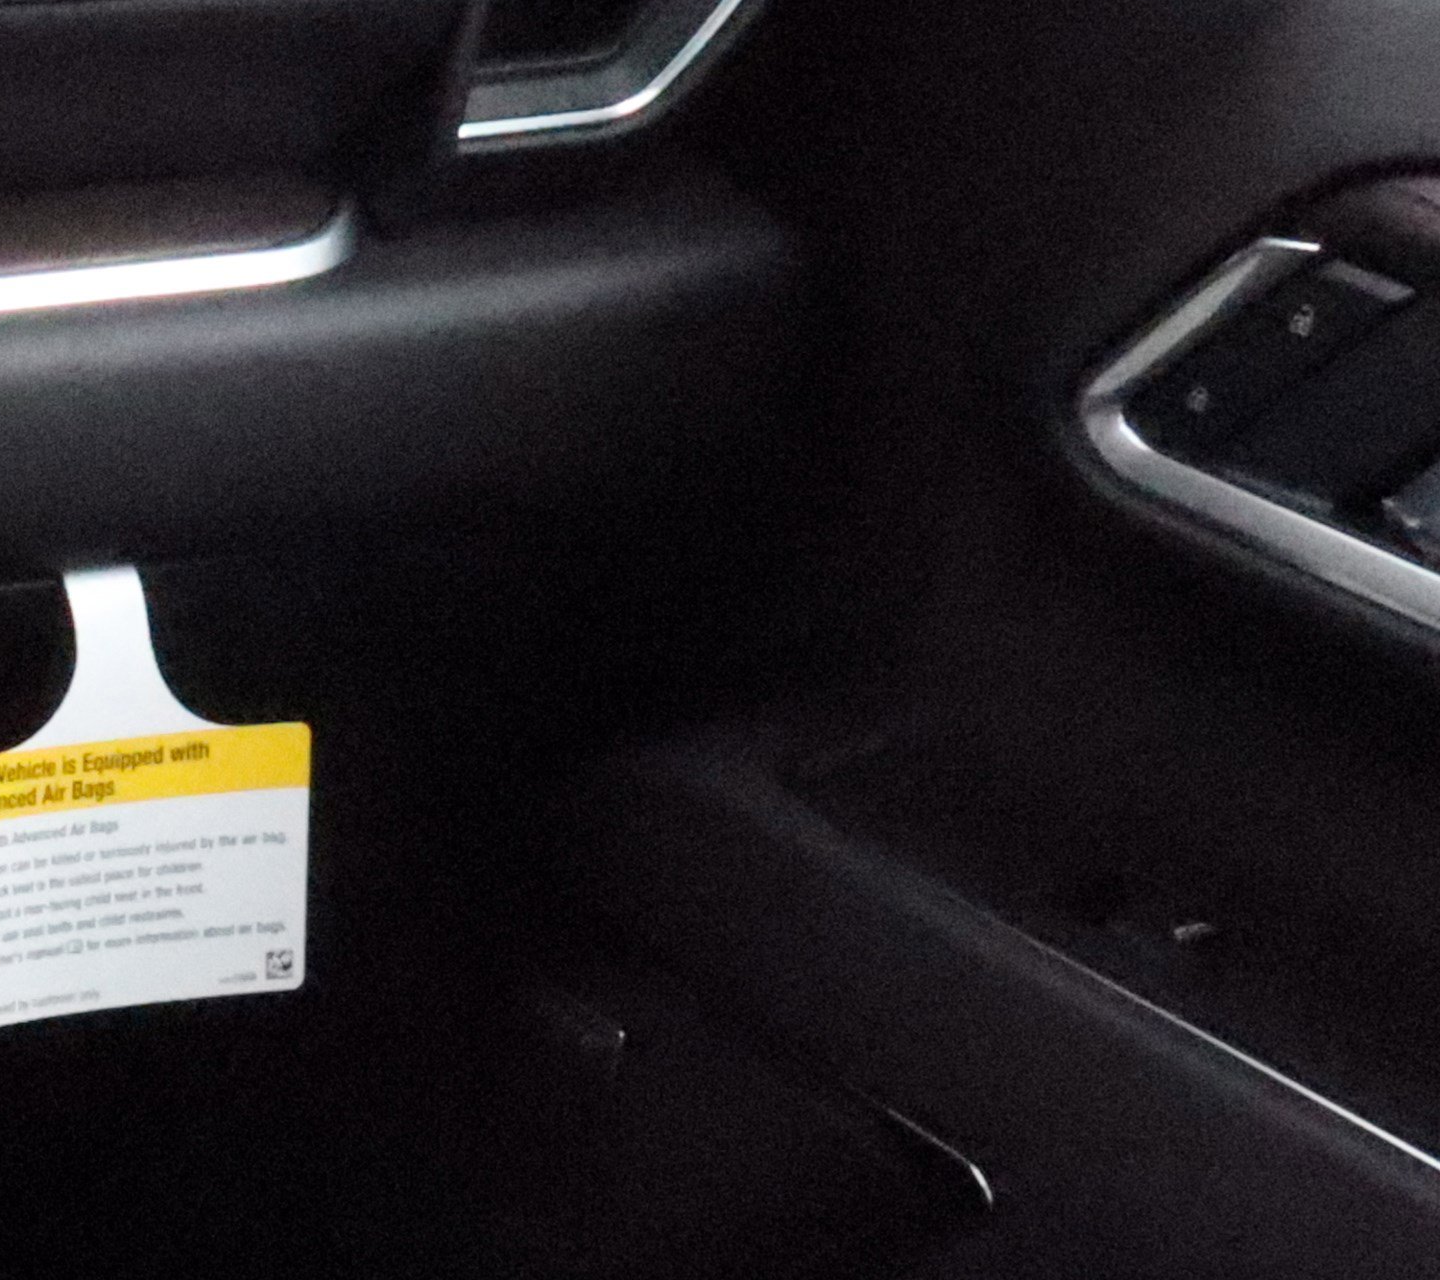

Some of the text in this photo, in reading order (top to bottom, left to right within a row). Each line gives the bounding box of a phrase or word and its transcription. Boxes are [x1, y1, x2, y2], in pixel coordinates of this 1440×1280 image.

[82, 747, 164, 774] Equipped
[169, 741, 210, 763] with
[42, 783, 67, 803] Air
[72, 779, 115, 802] Bags
[12, 824, 67, 843] Advanced
